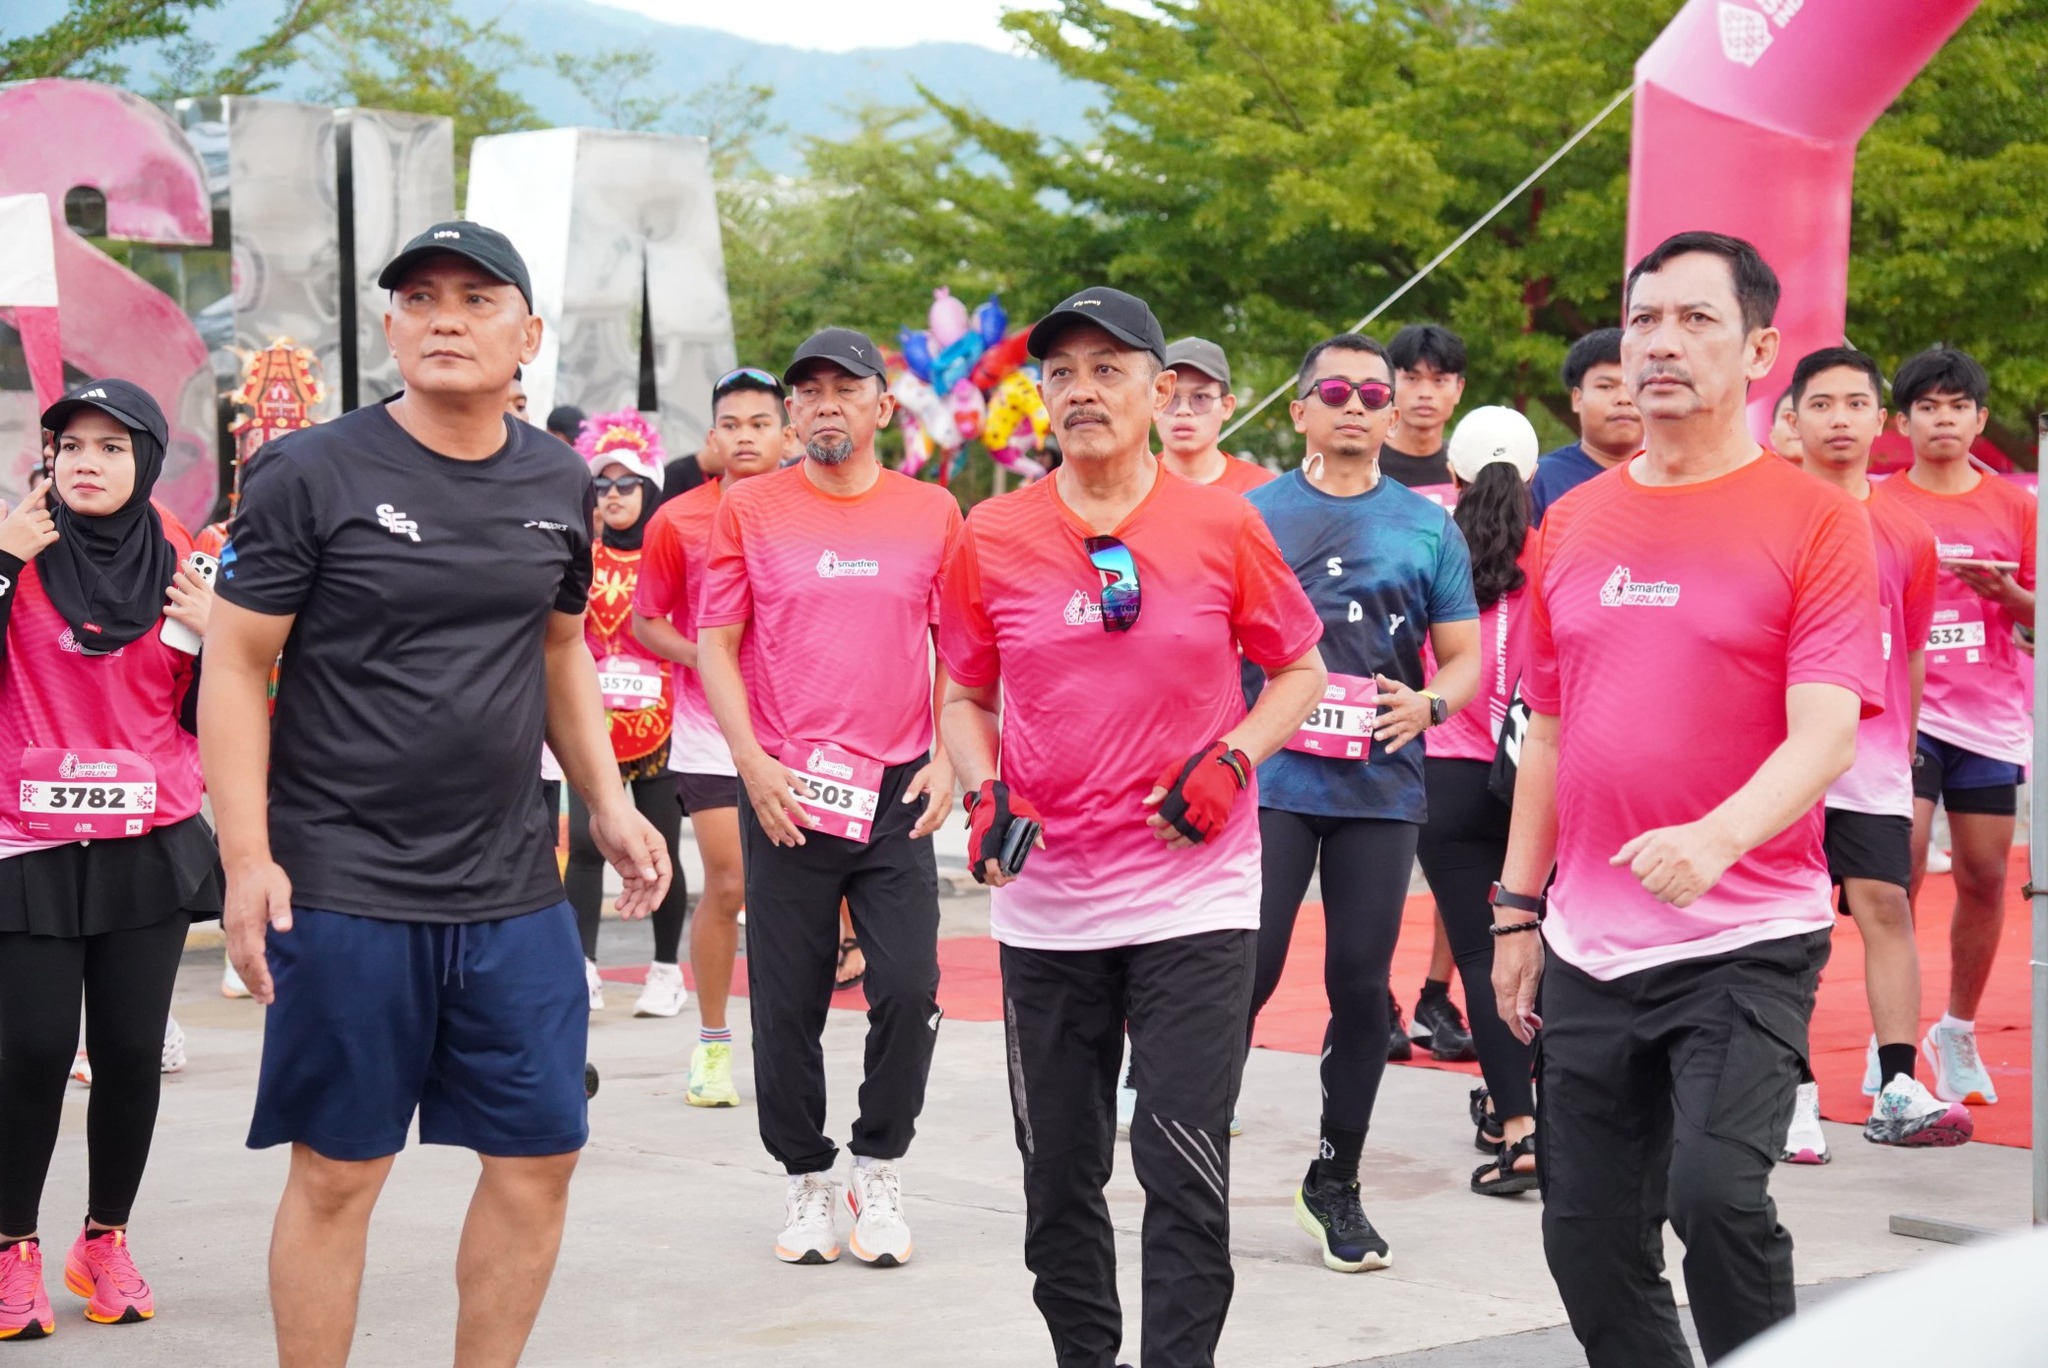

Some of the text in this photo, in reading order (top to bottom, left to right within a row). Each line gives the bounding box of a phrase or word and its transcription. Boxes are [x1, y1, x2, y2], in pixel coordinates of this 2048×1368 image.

[538, 520, 569, 532] BROOKS
[838, 560, 877, 568] smartfren
[1327, 556, 1343, 576] S
[1629, 582, 1679, 594] smartfren
[1634, 594, 1668, 604] RUN
[1389, 613, 1406, 636] Y
[1928, 628, 1965, 645] 632
[1496, 613, 1508, 696] SMARTFREN
[602, 677, 643, 692] 3570
[78, 762, 116, 770] smartfren
[50, 786, 126, 809] 3782
